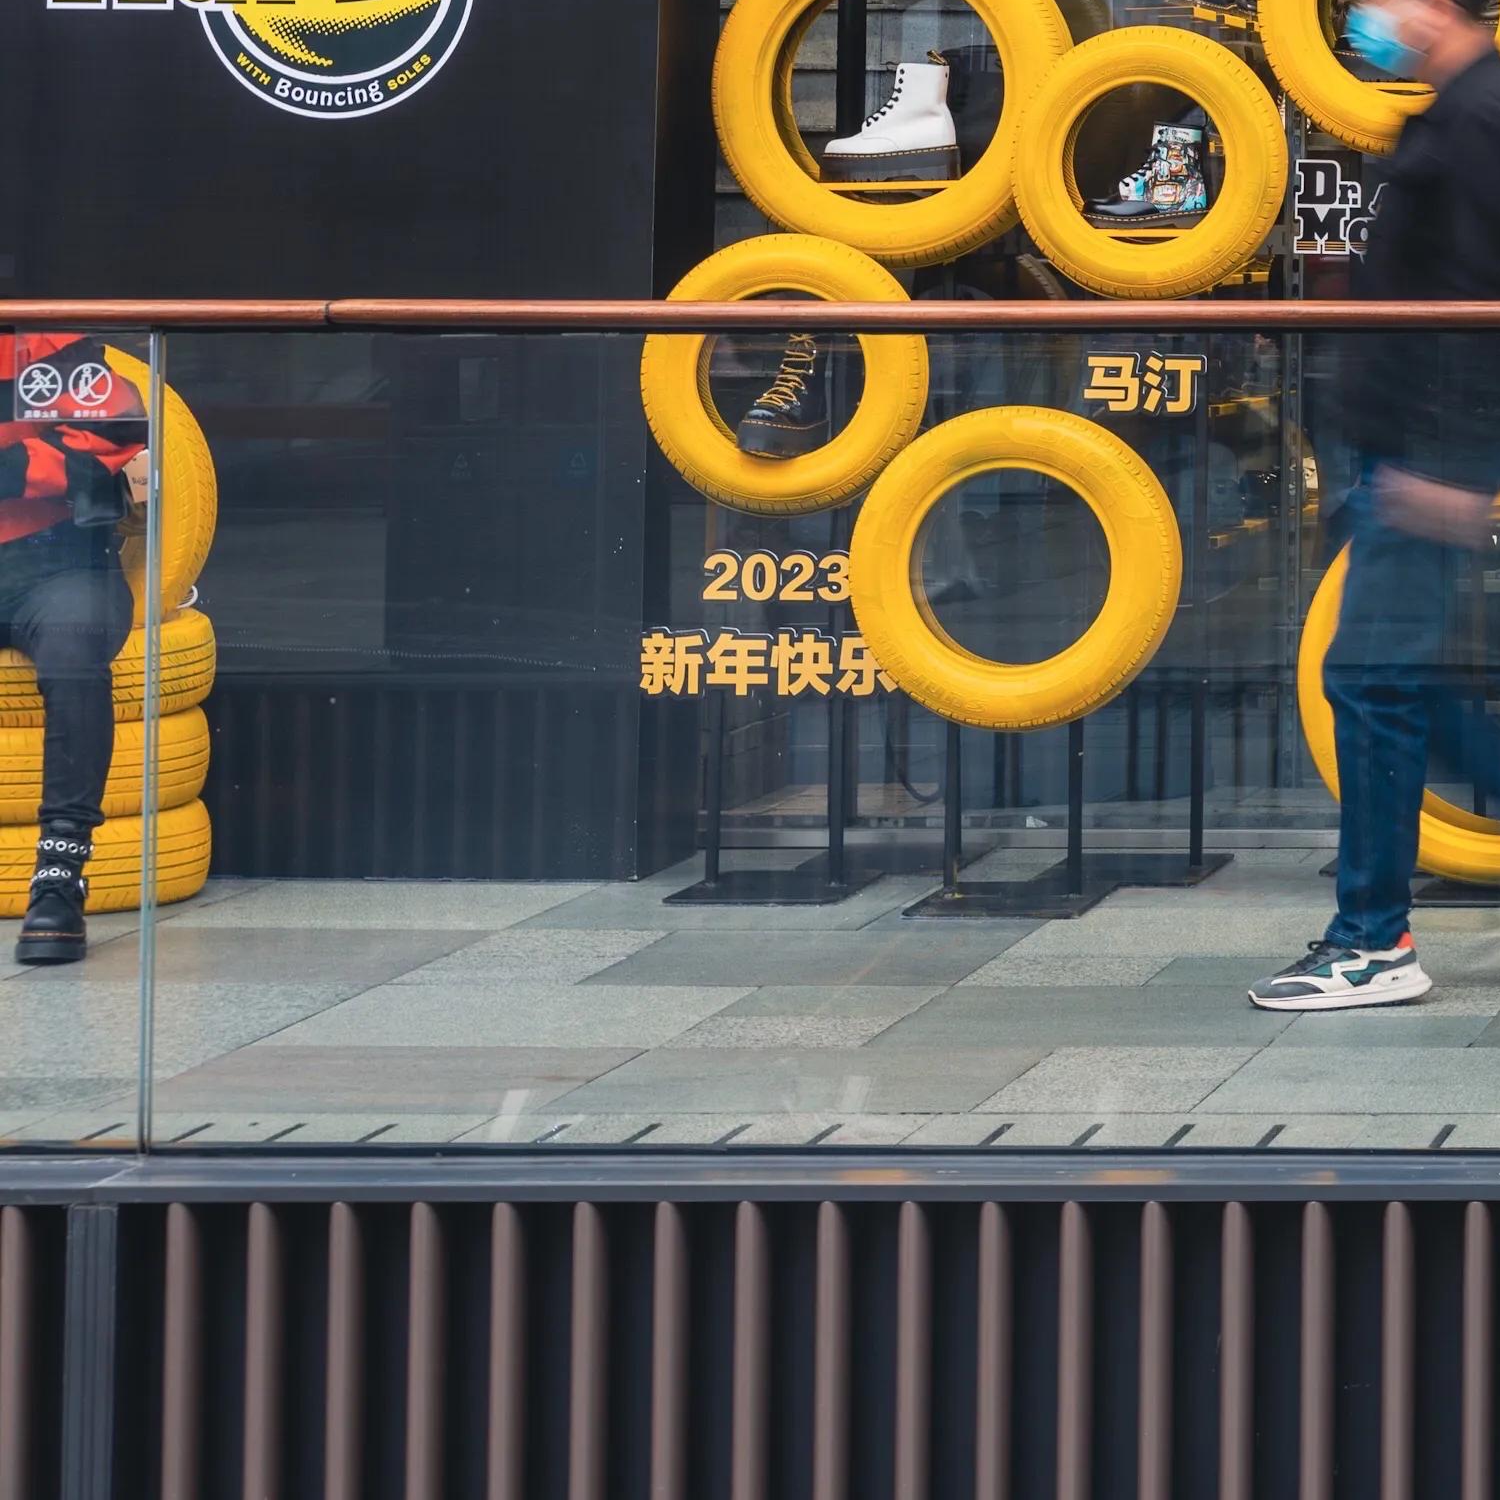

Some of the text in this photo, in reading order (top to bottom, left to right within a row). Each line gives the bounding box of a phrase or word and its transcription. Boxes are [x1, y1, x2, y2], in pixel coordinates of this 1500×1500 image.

[235, 51, 432, 109] WITH Bouncing SOLES
[1083, 355, 1204, 414] 马汀
[701, 551, 852, 602] 2023
[638, 630, 899, 697] 新年快乐
